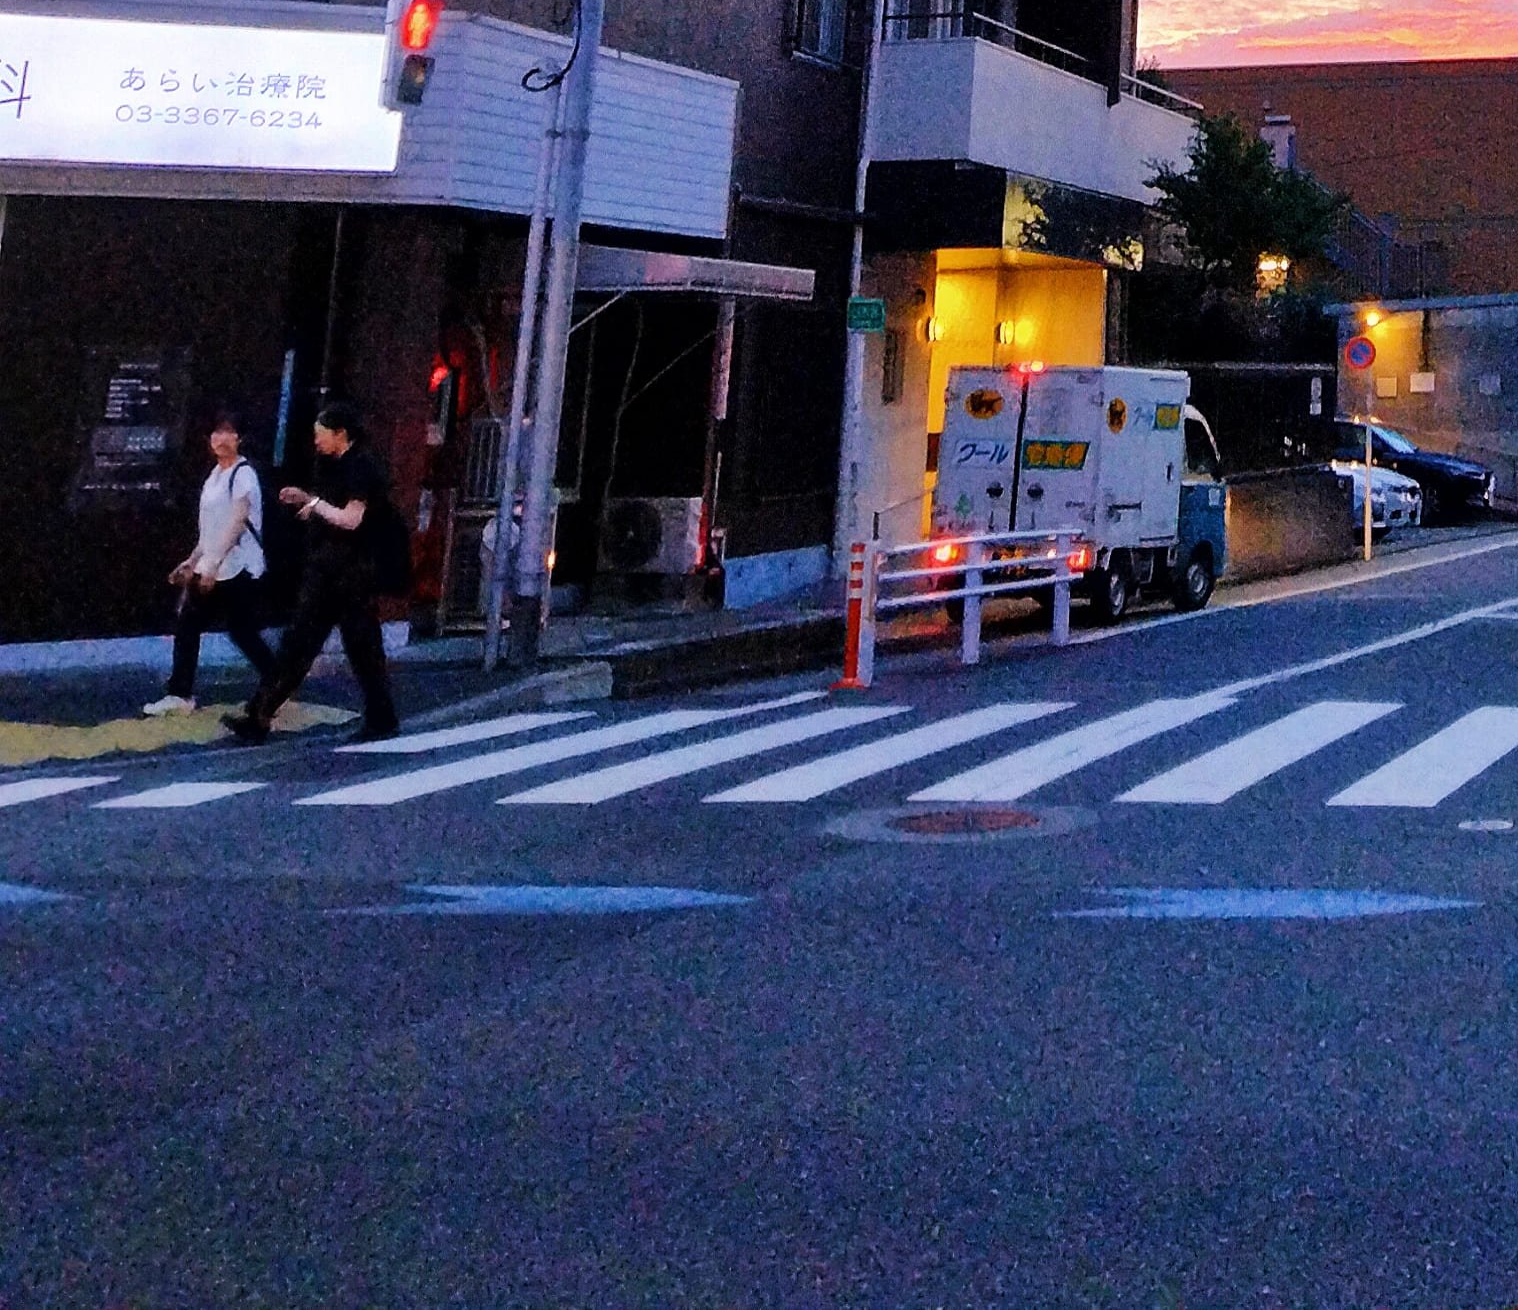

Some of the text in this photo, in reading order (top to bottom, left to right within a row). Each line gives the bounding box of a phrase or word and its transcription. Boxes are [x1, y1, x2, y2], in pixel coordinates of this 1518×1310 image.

[120, 66, 327, 100] あらい治療院
[115, 104, 322, 129] 03-3367-6234
[957, 442, 1009, 465] クール
